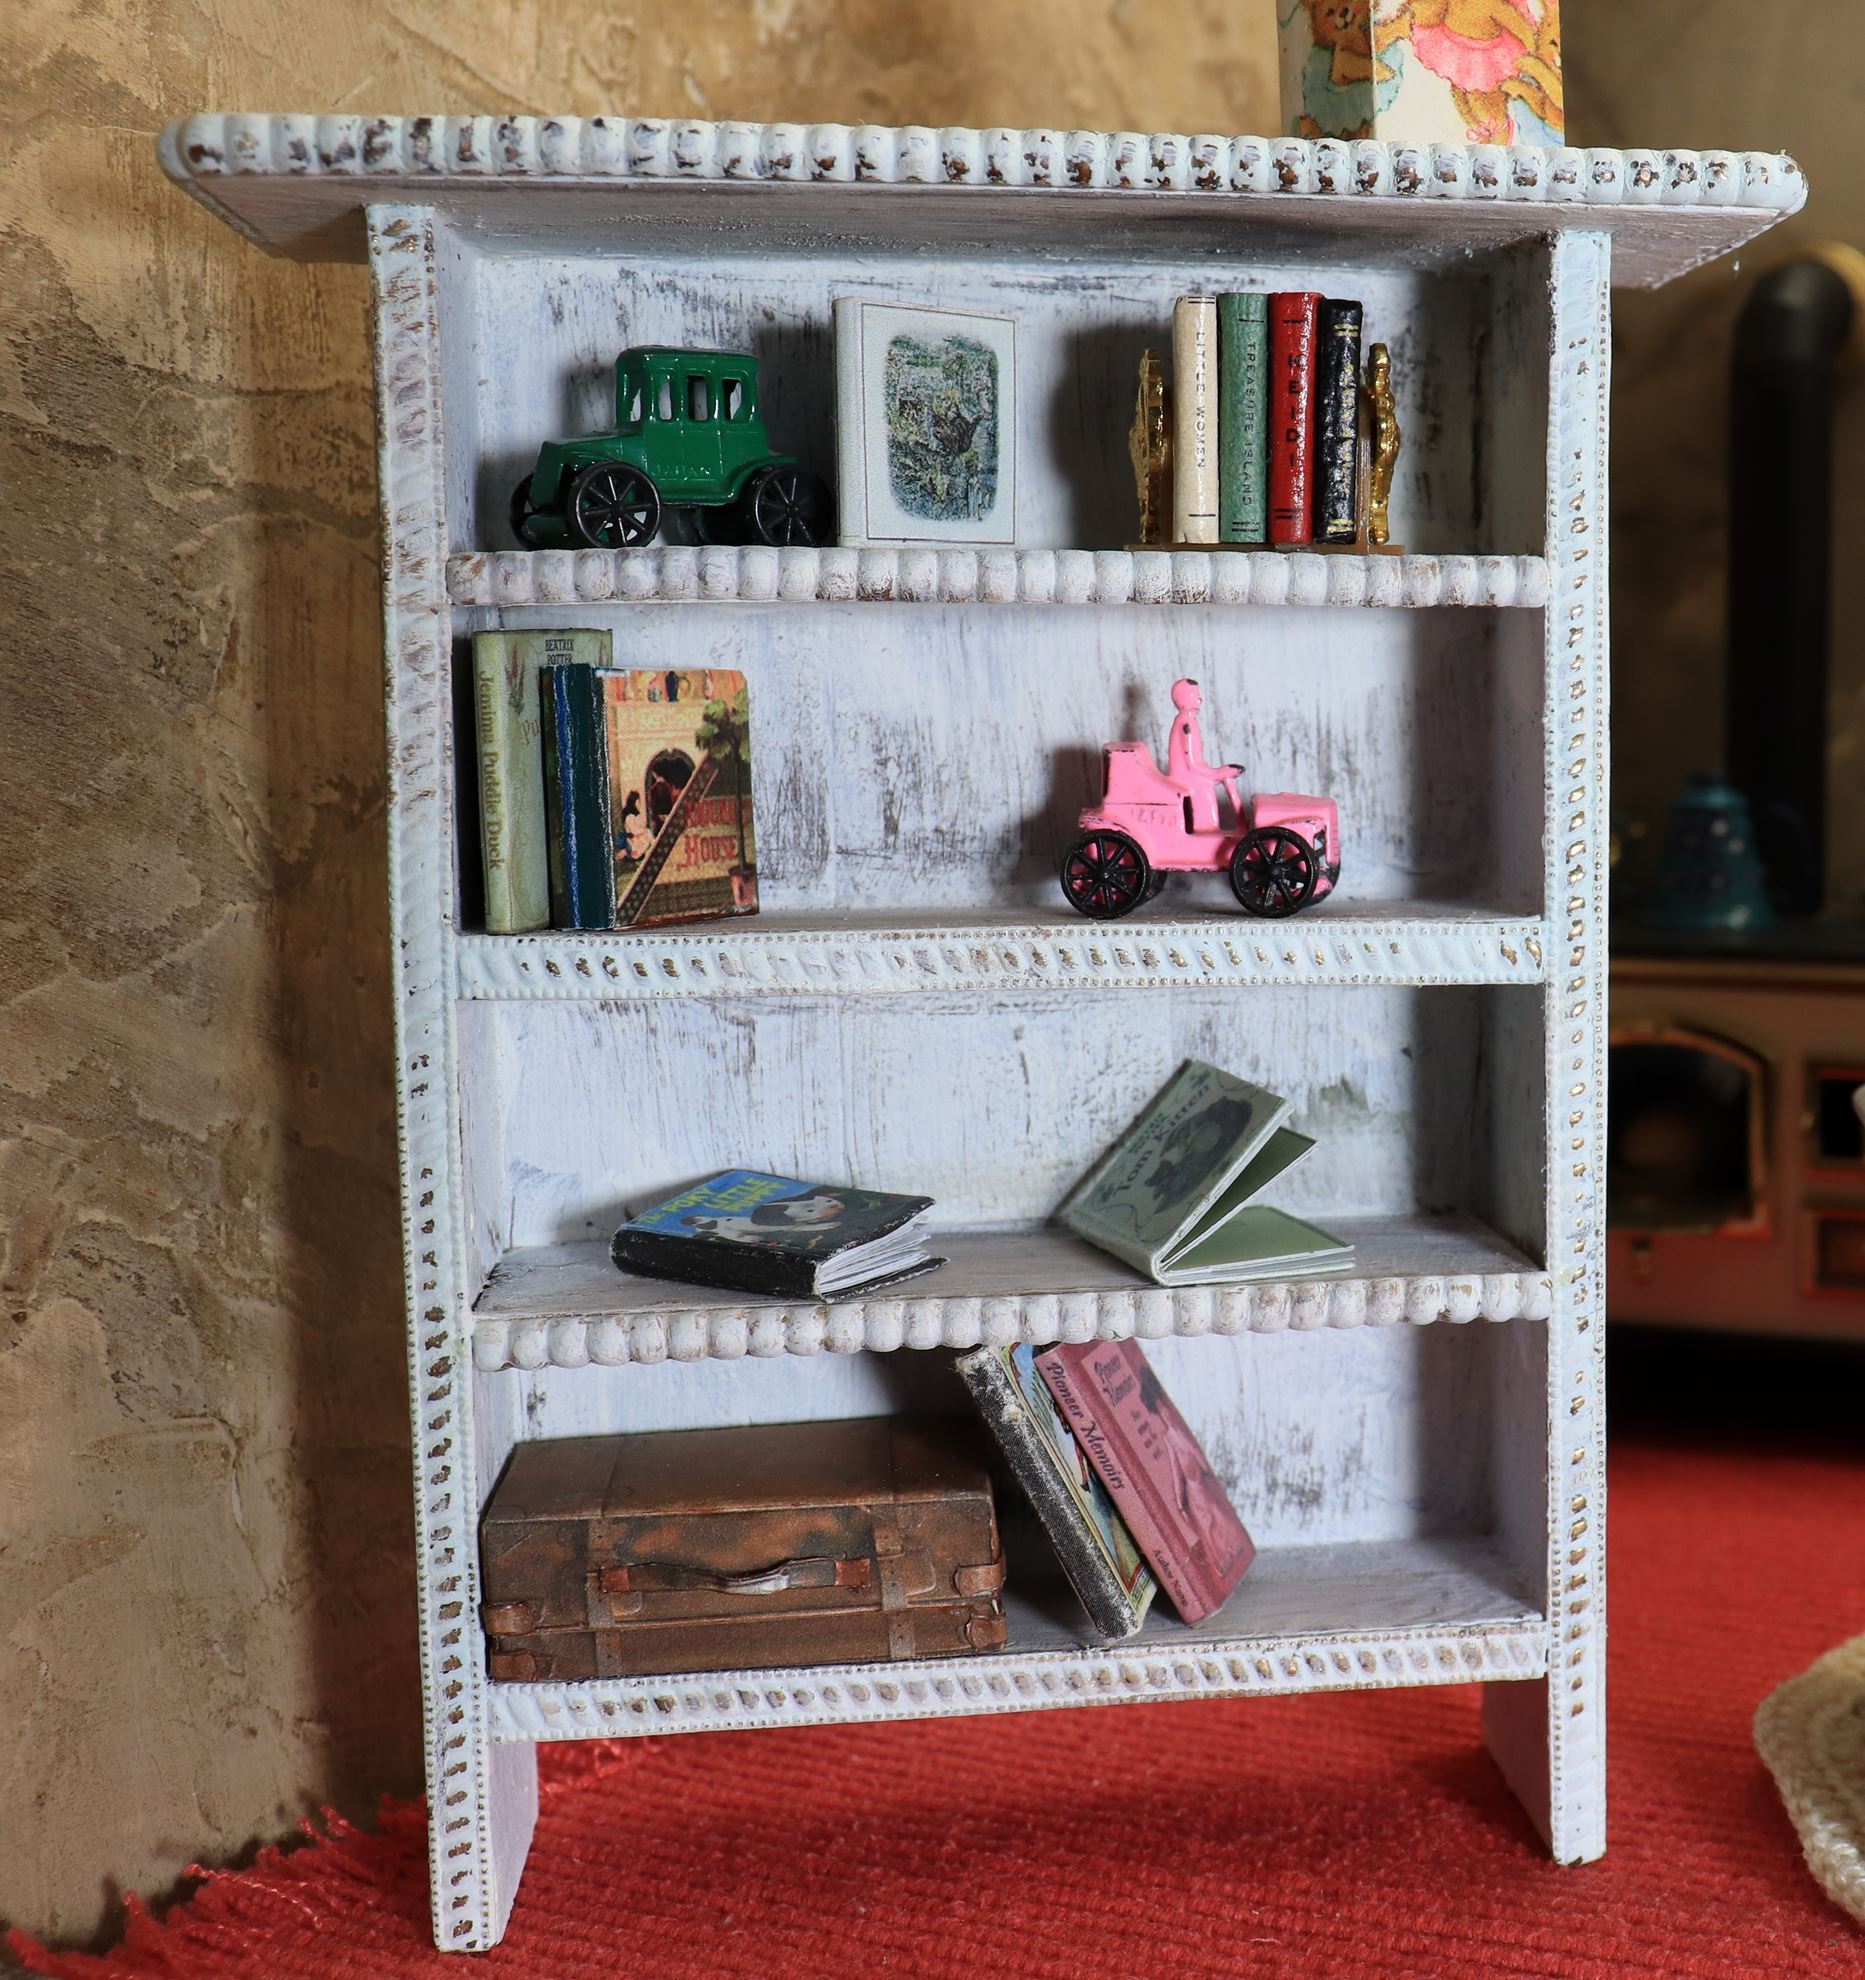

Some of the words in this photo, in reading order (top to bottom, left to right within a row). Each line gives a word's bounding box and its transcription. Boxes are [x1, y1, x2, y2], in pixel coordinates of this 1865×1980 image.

[1196, 332, 1206, 393] LITTLE
[1245, 342, 1256, 433] TREASURE
[1196, 405, 1206, 468] WOMEN
[1286, 355, 1303, 467] HEIDI
[1243, 442, 1254, 506] ISLAND
[545, 639, 575, 652] BEATRIX
[546, 653, 573, 666] POTTER
[479, 670, 497, 744] Jemima
[485, 750, 501, 812] Puddle
[487, 820, 504, 870] Duck
[1112, 1151, 1154, 1195] Tom
[1152, 1084, 1209, 1141] Kitten
[1045, 1360, 1085, 1421] Pioneer
[1081, 1421, 1125, 1491] Memoirs
